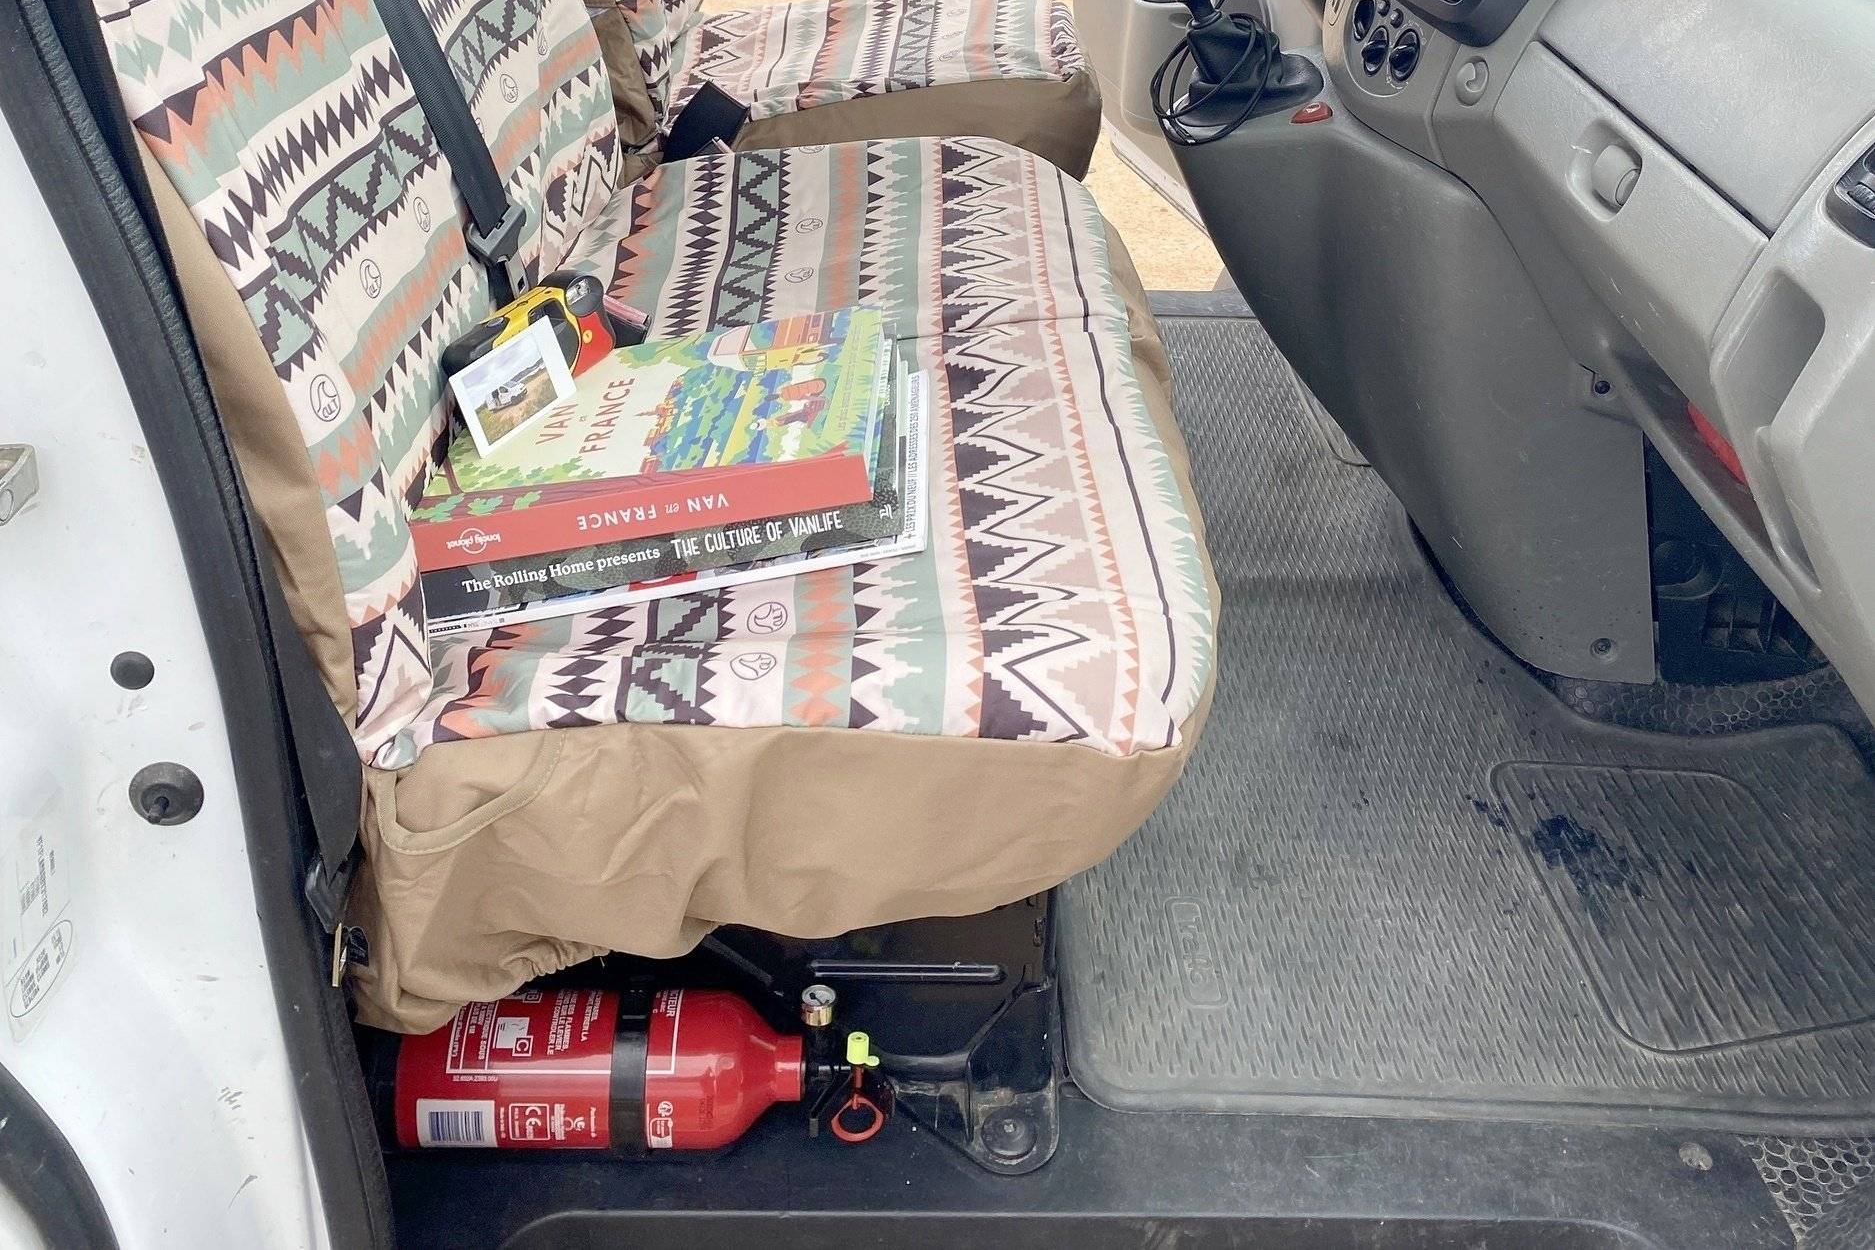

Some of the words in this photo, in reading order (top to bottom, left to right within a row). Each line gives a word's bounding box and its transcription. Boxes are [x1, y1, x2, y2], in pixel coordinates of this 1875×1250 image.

[535, 404, 578, 445] VAN
[579, 378, 635, 454] FRANCE
[665, 502, 680, 514] en
[688, 493, 729, 513] VAN
[578, 504, 657, 531] FRANCE
[446, 535, 475, 550] planet
[474, 532, 501, 546] lonely
[462, 579, 492, 593] The
[494, 569, 548, 588] Rolling
[549, 560, 595, 578] Home
[596, 547, 661, 573] presents
[671, 538, 700, 560] THE
[705, 526, 761, 553] CULTURE
[766, 521, 783, 542] OF
[788, 510, 843, 538] VANLIFE
[516, 1038, 530, 1052] C
[554, 1026, 564, 1051] LEVIER
[478, 1040, 489, 1060] SOUS
